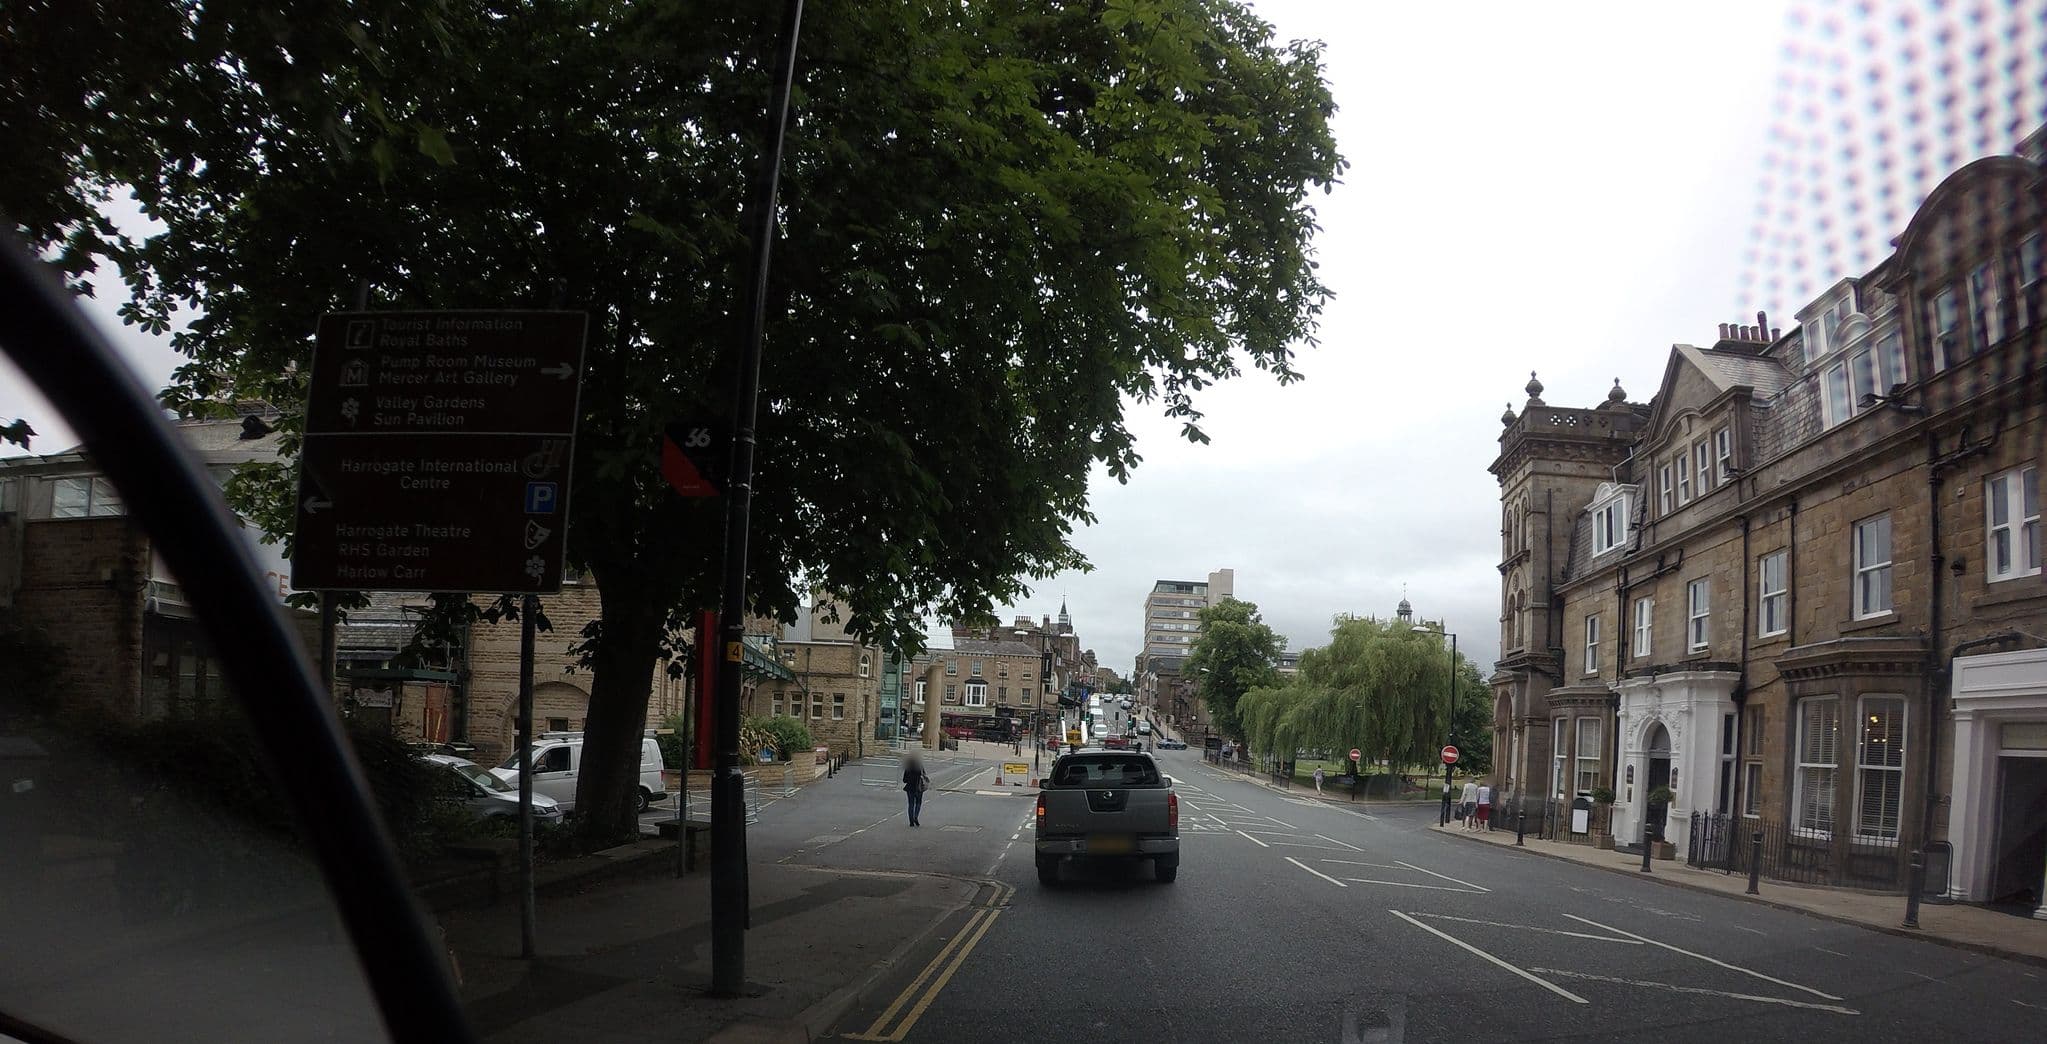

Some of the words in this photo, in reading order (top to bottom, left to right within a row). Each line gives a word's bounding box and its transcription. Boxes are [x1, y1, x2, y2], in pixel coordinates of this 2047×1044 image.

[382, 318, 430, 330] Tourist
[436, 318, 523, 330] Information
[380, 334, 420, 348] Royal
[425, 334, 468, 346] Baths
[381, 356, 419, 370] Pump
[426, 356, 469, 368] Room
[474, 356, 537, 368] Museum
[379, 372, 430, 384] Mercer
[435, 372, 457, 384] Art
[463, 371, 520, 387] Gallery
[376, 396, 418, 411] Valley
[423, 396, 486, 409] Gardens
[374, 413, 401, 426] Sun
[407, 413, 465, 426] Pavilion
[341, 460, 415, 474] Harrogate
[420, 460, 518, 473] International
[400, 476, 451, 490] Centre
[533, 487, 554, 510] P
[336, 523, 408, 538] Harrogate
[414, 524, 472, 538] Theatre
[338, 544, 370, 557] RHS
[376, 543, 430, 557] Garden
[337, 566, 390, 579] Harlow
[394, 565, 426, 578] Carr
